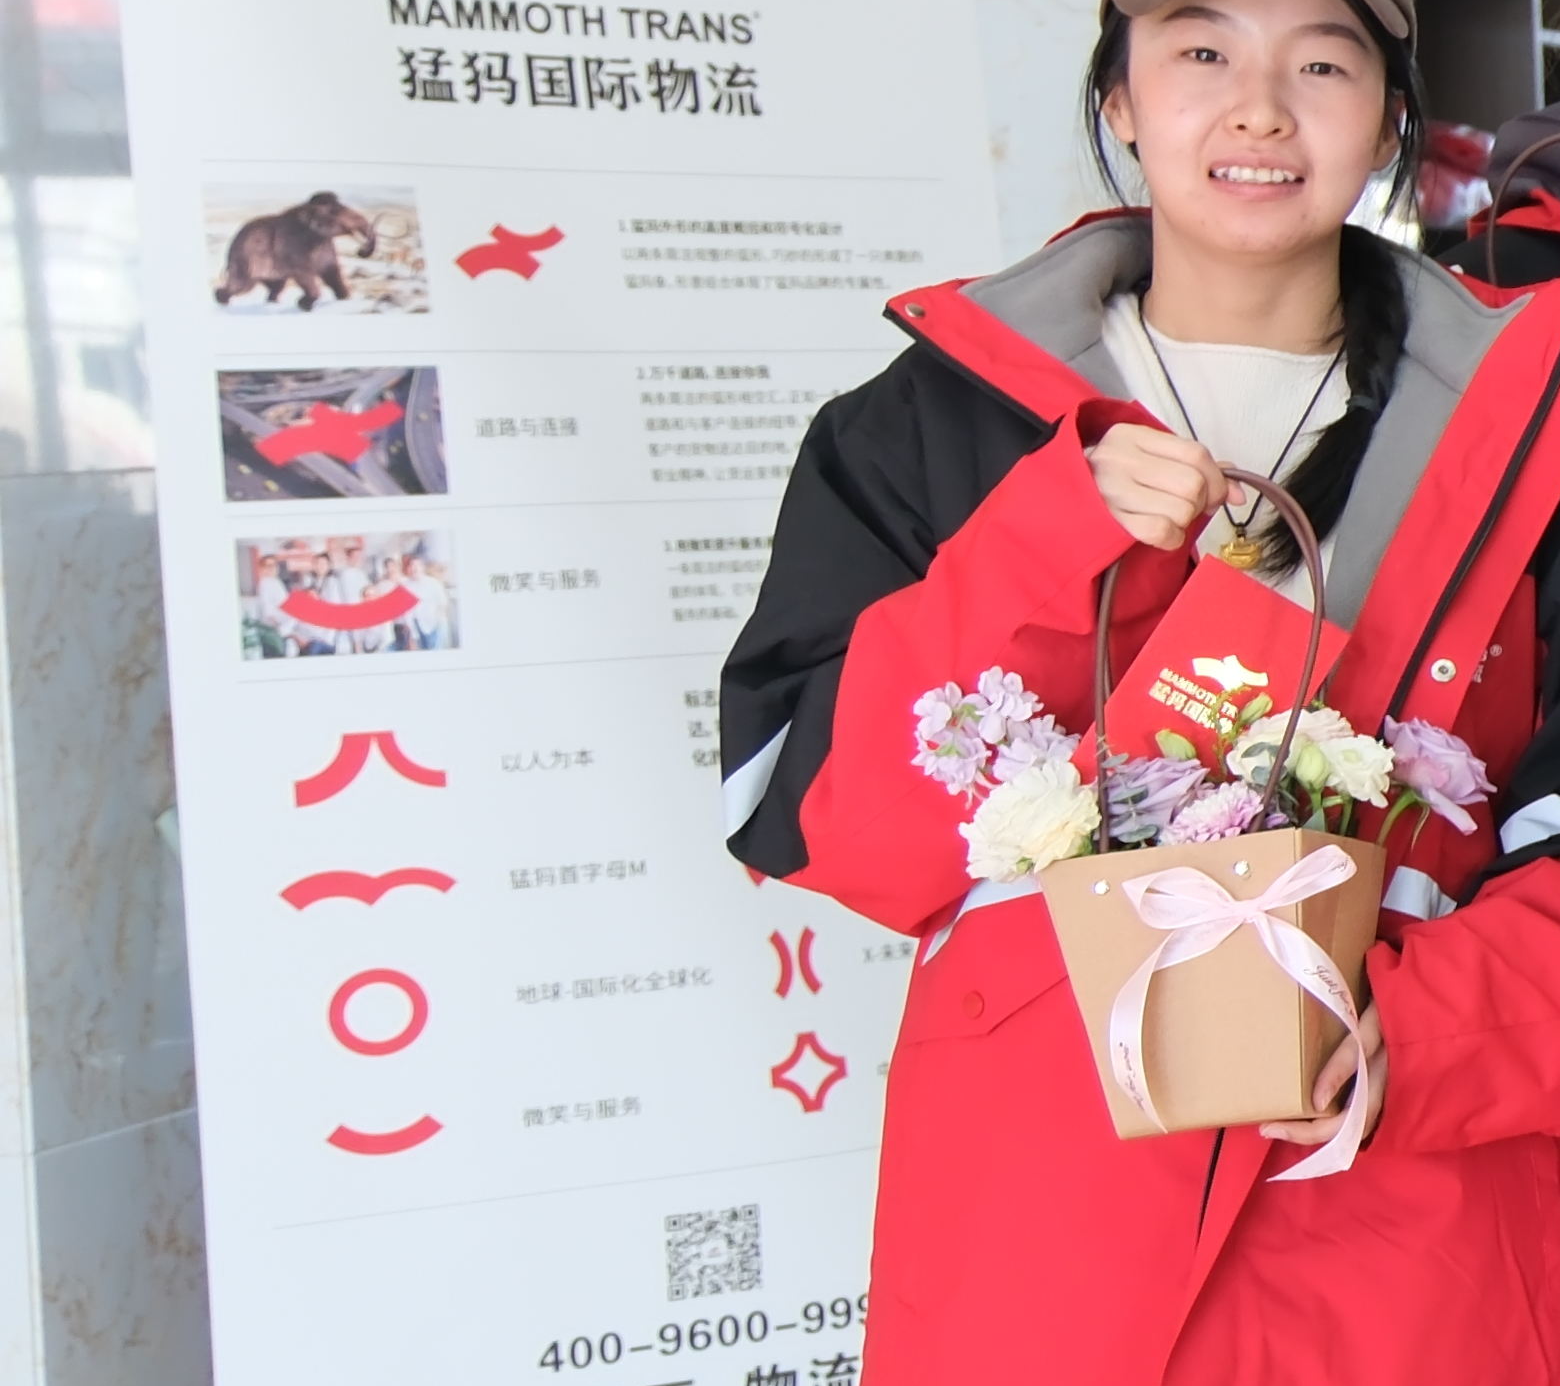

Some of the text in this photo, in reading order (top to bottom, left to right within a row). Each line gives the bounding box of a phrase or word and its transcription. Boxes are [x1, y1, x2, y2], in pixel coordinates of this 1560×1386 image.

[396, 46, 763, 116] 猛犸国际物流
[475, 416, 580, 439] 道路与连接
[488, 568, 601, 595] 微笑与服务
[501, 748, 595, 773] 以人为本
[509, 859, 648, 890] 猛犸首字母M
[515, 967, 714, 1006] 地球-国际化全球化
[523, 1096, 642, 1129] 微笑与服务
